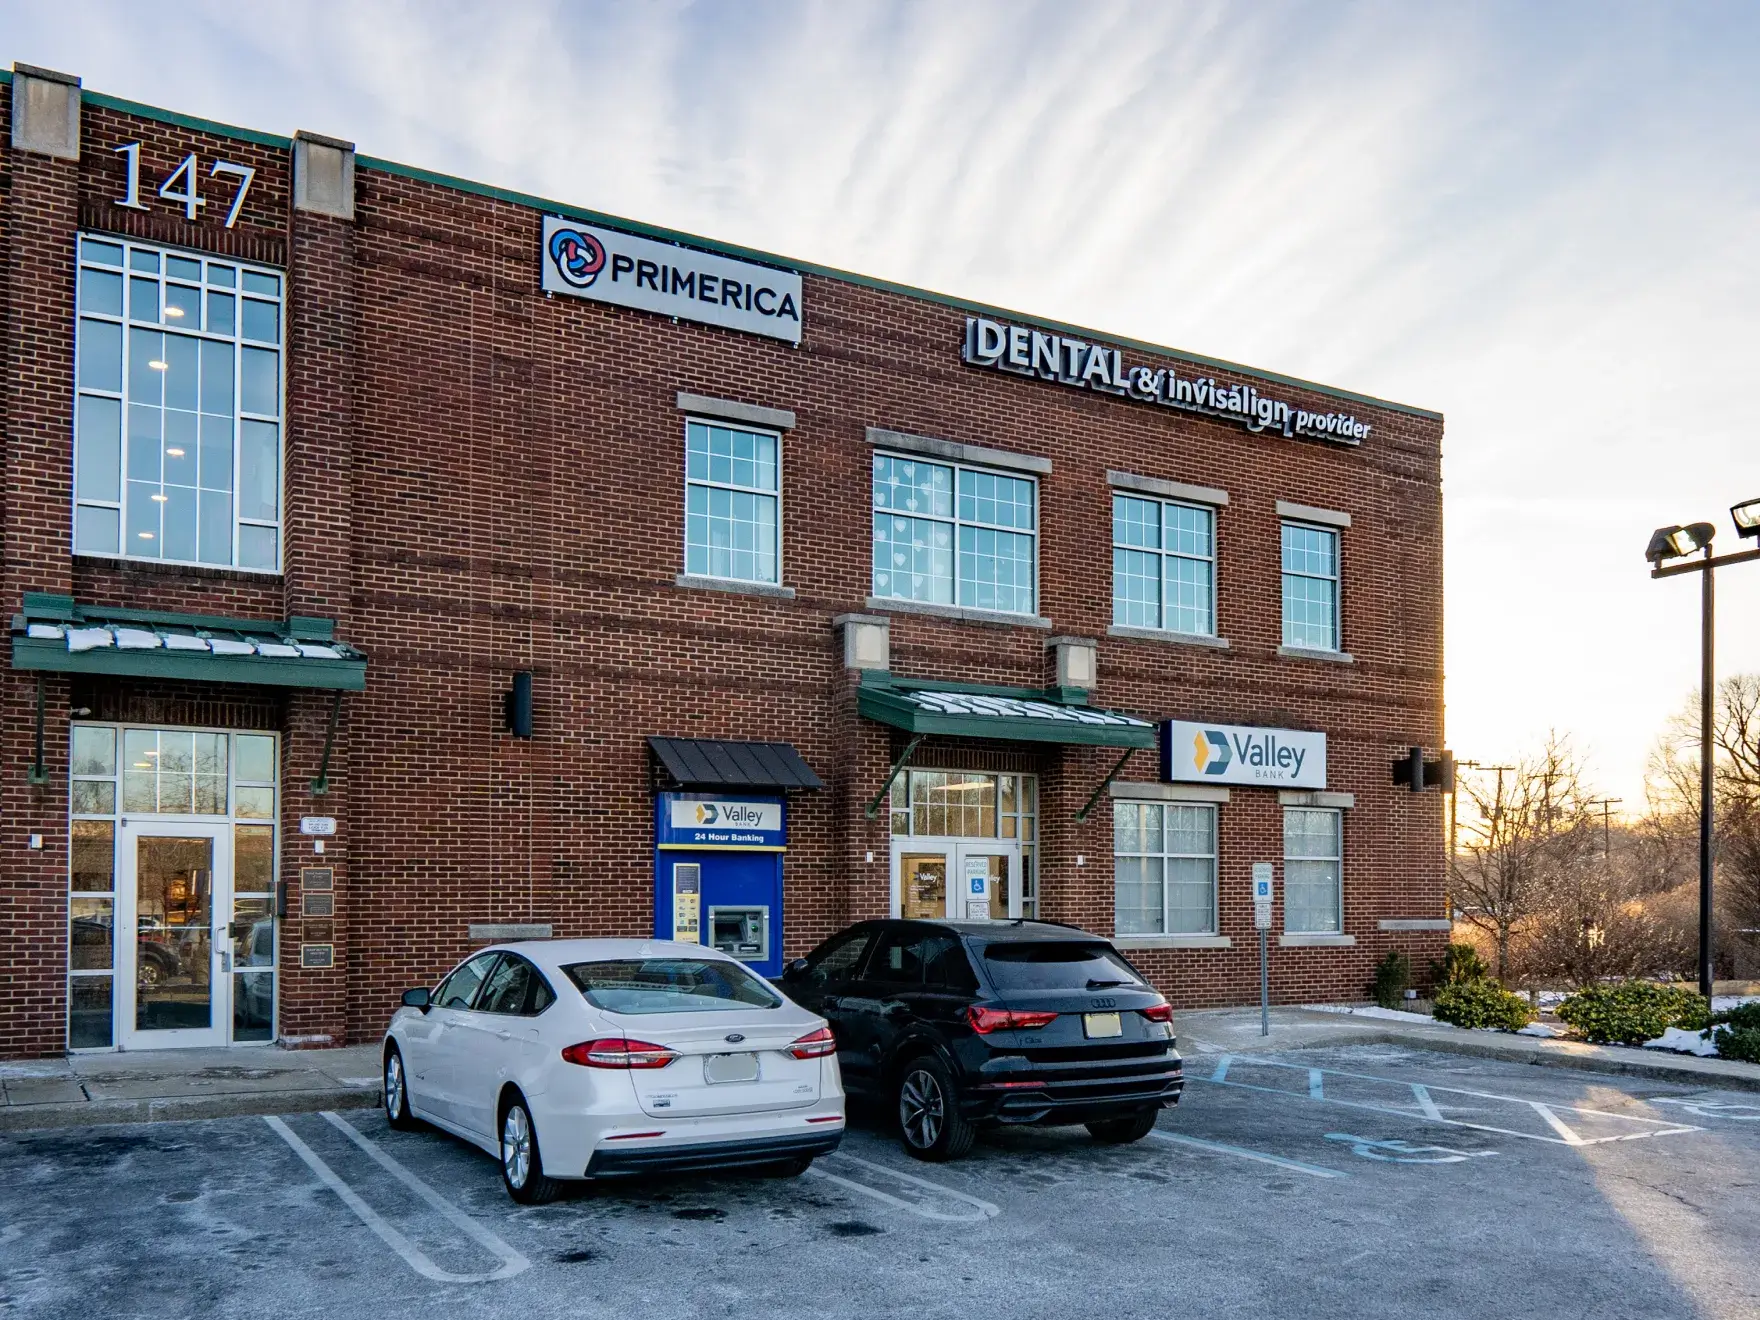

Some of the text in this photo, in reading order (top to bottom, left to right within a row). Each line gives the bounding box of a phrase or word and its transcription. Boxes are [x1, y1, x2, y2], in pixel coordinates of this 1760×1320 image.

[113, 142, 257, 229] 147
[612, 253, 799, 322] PRIMERICA
[976, 317, 1372, 440] DENTAL & invisalign provider
[1232, 732, 1306, 779] Valley
[1255, 769, 1285, 780] BANK
[722, 805, 763, 827] Valley
[694, 832, 764, 844] 24 Hour Banking
[919, 872, 938, 883] Valley
